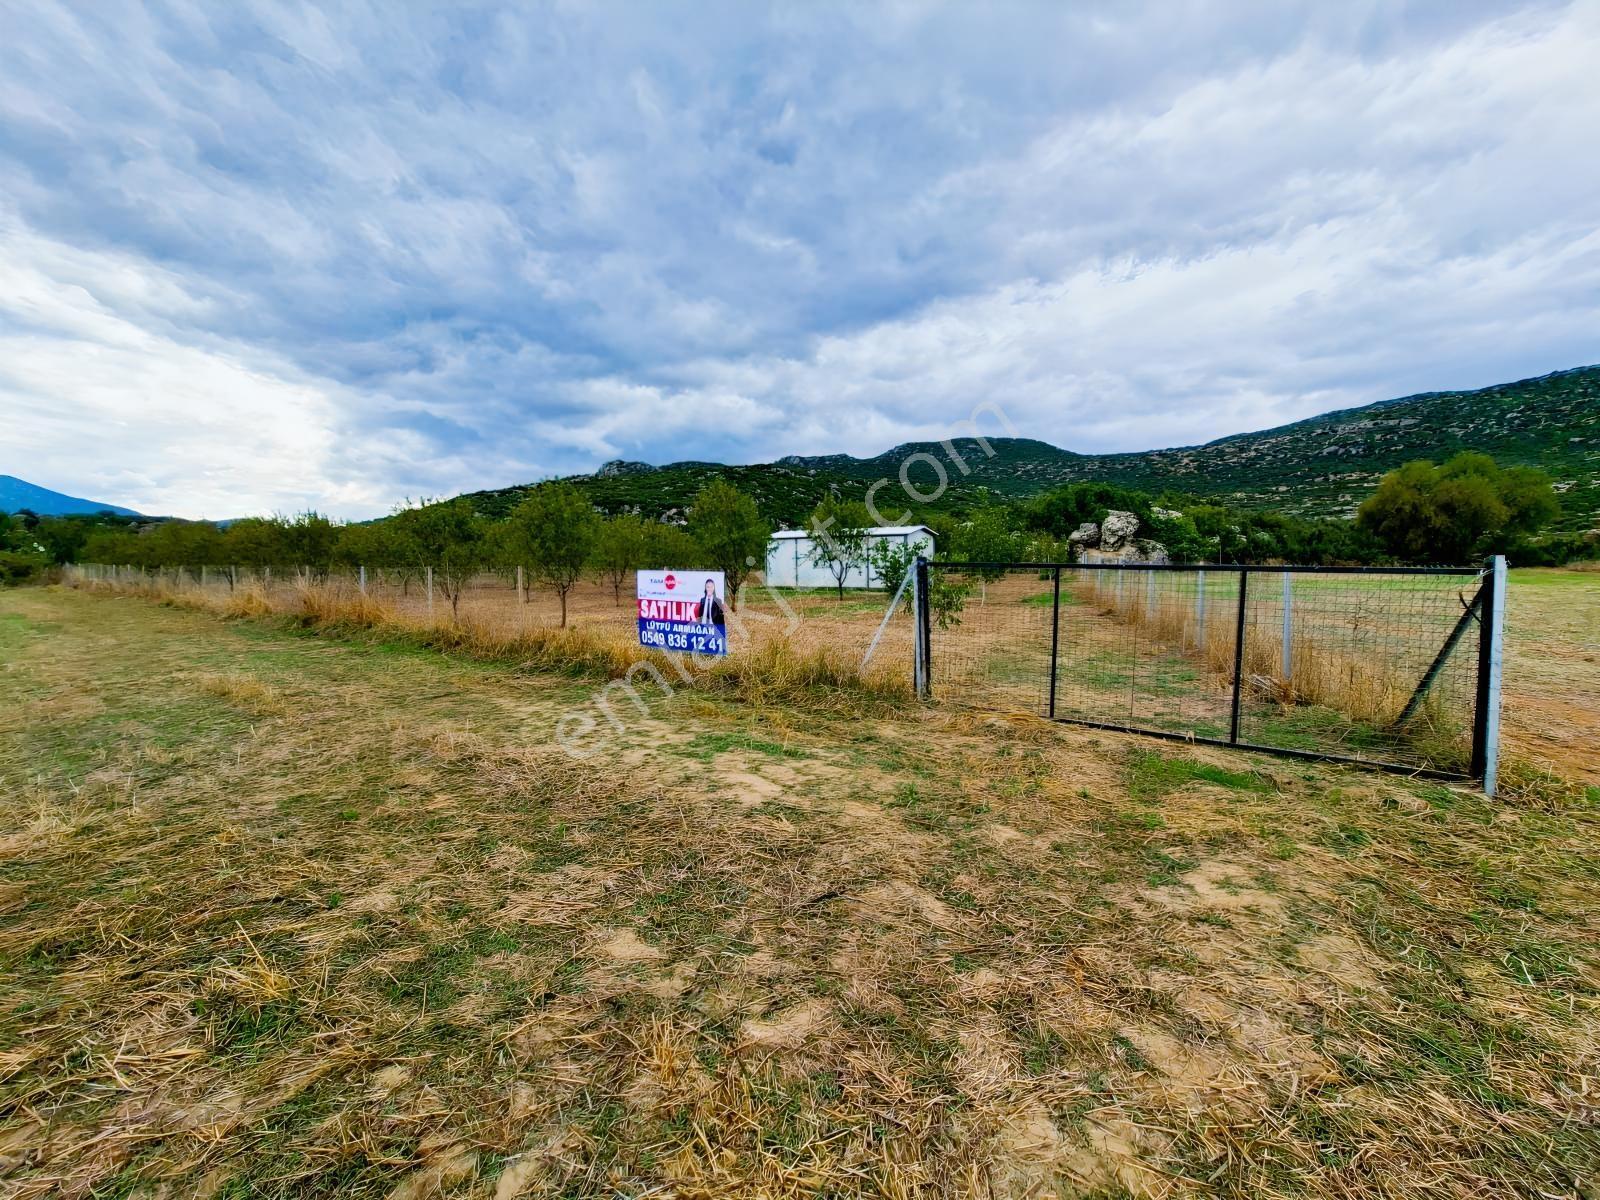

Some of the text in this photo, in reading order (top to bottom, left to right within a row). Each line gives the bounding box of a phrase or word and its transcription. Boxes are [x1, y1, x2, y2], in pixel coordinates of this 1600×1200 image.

[640, 600, 697, 622] SATILIK
[641, 630, 723, 652] 0549 836 12 41
